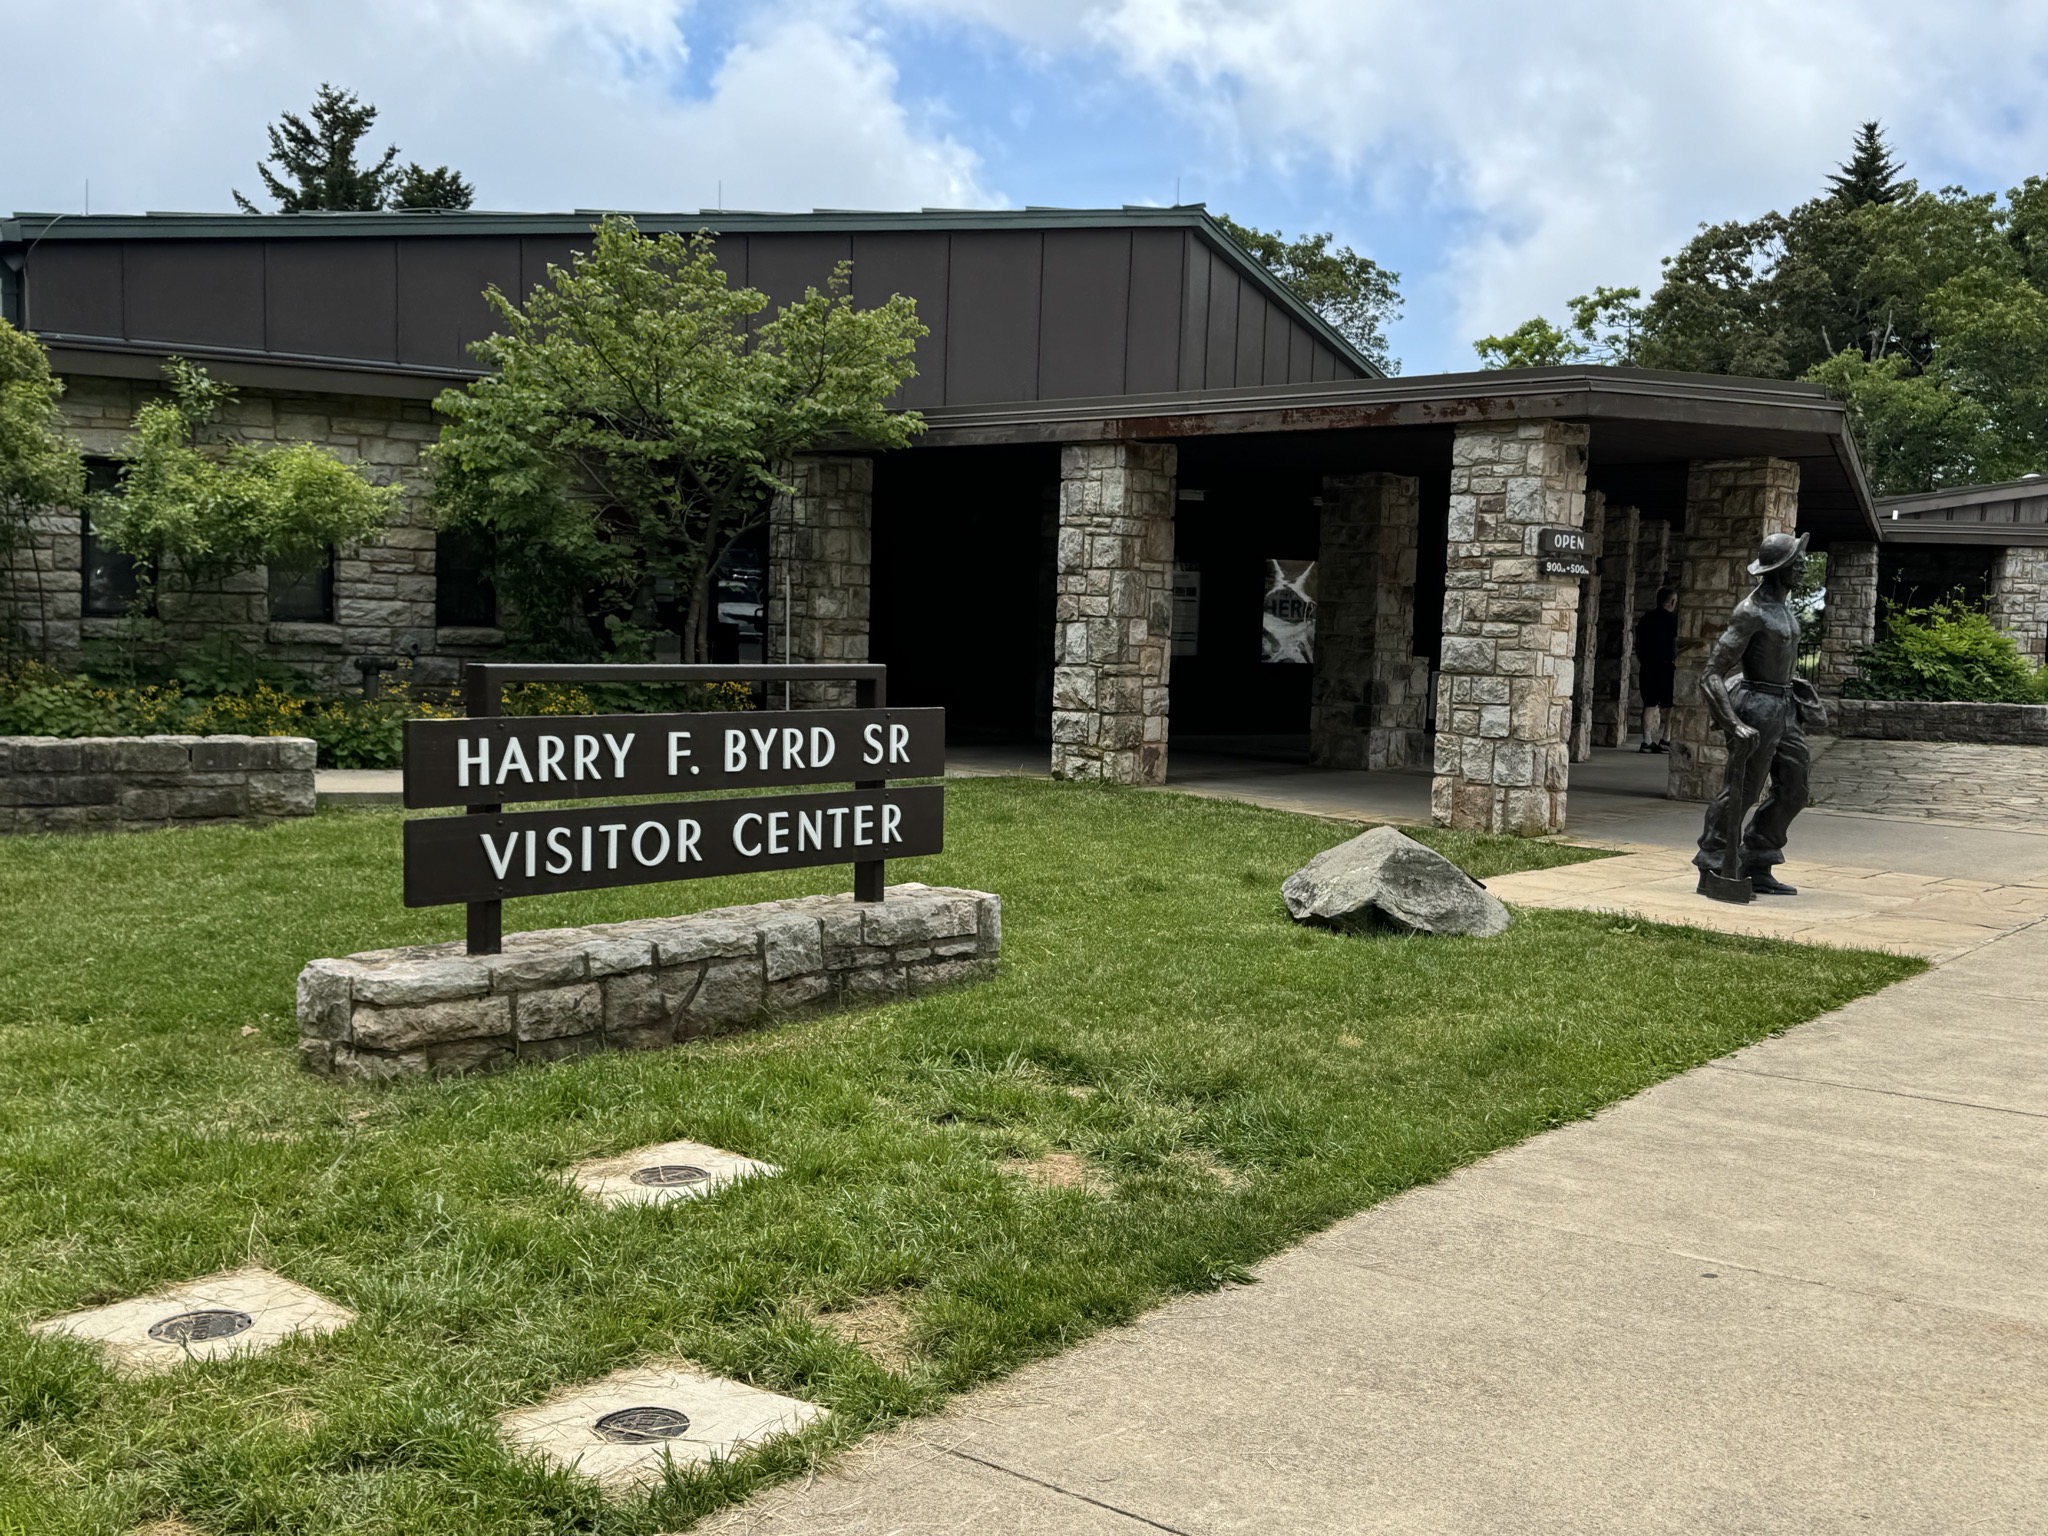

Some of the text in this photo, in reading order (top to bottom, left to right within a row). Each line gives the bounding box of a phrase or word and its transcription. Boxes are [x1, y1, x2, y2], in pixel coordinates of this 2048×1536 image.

[1554, 533, 1585, 550] OPEN
[457, 723, 911, 788] HARRY F. BYRD SR
[479, 803, 903, 880] VISITOR CENTER
